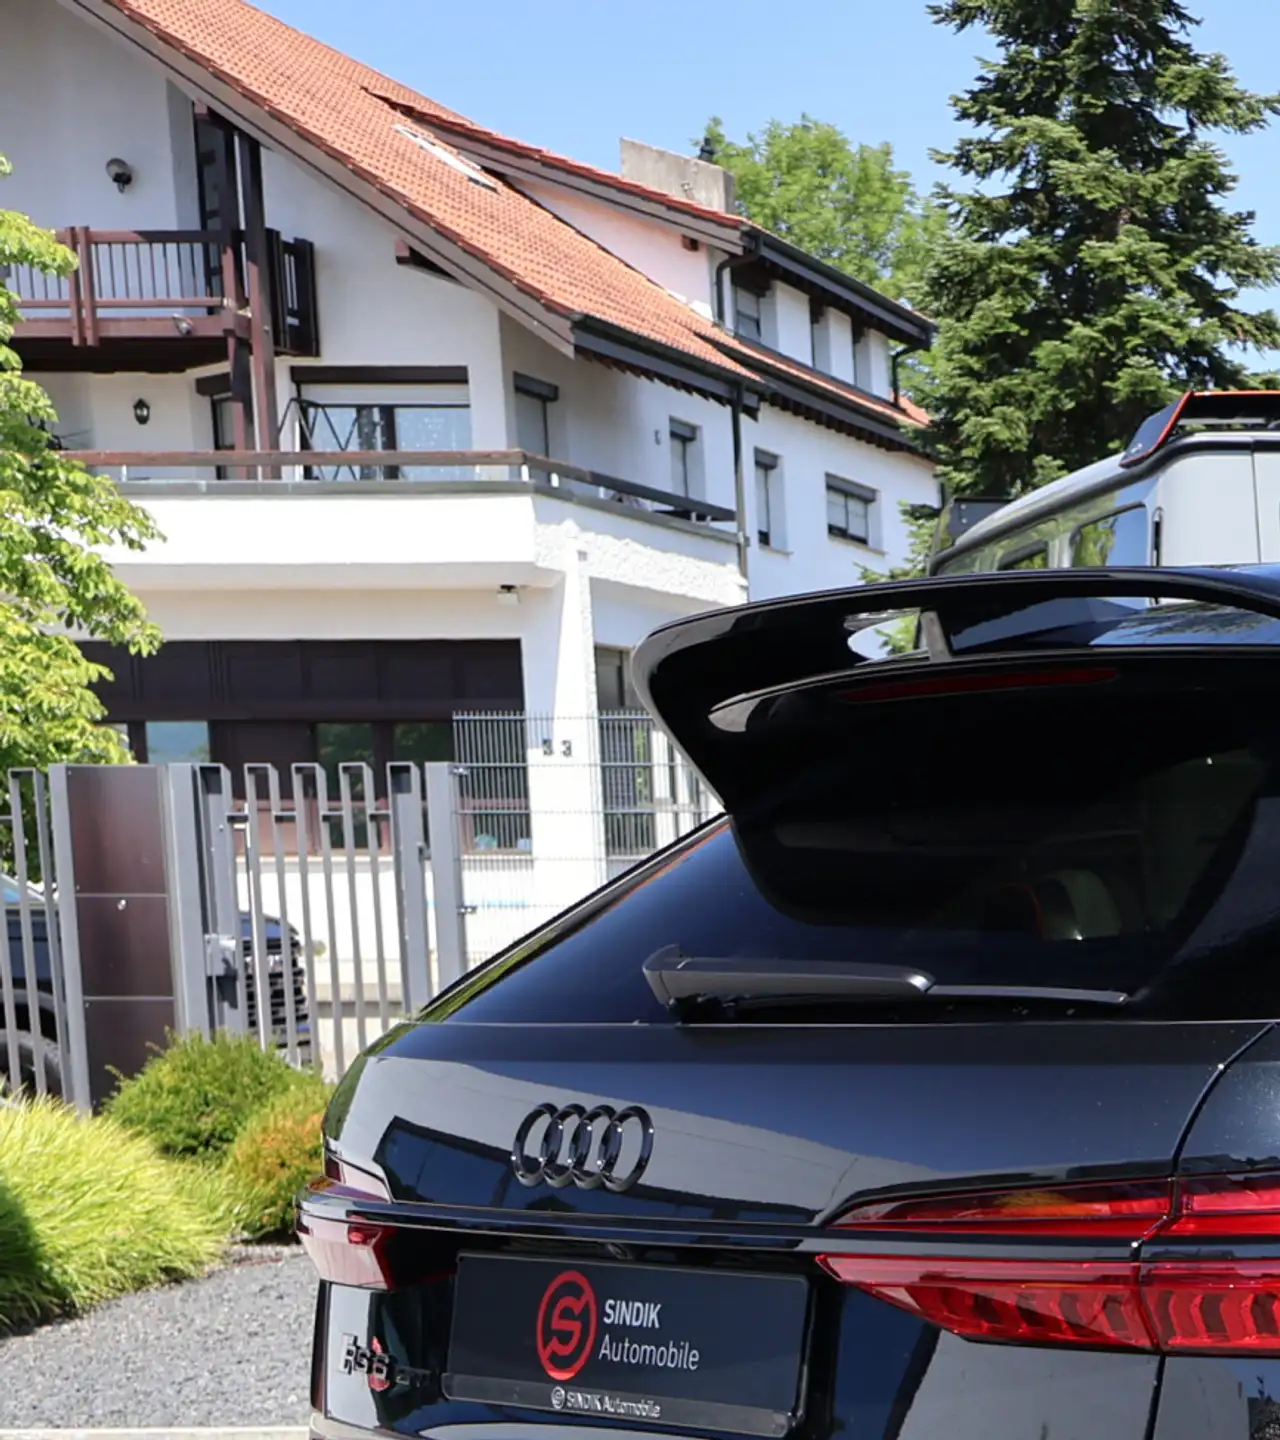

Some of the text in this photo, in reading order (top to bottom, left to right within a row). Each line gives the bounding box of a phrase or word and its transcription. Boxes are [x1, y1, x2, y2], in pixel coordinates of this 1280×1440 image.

[603, 1299, 661, 1328] SINDIK
[598, 1333, 700, 1370] Automobile
[602, 1395, 662, 1418] Automobile
